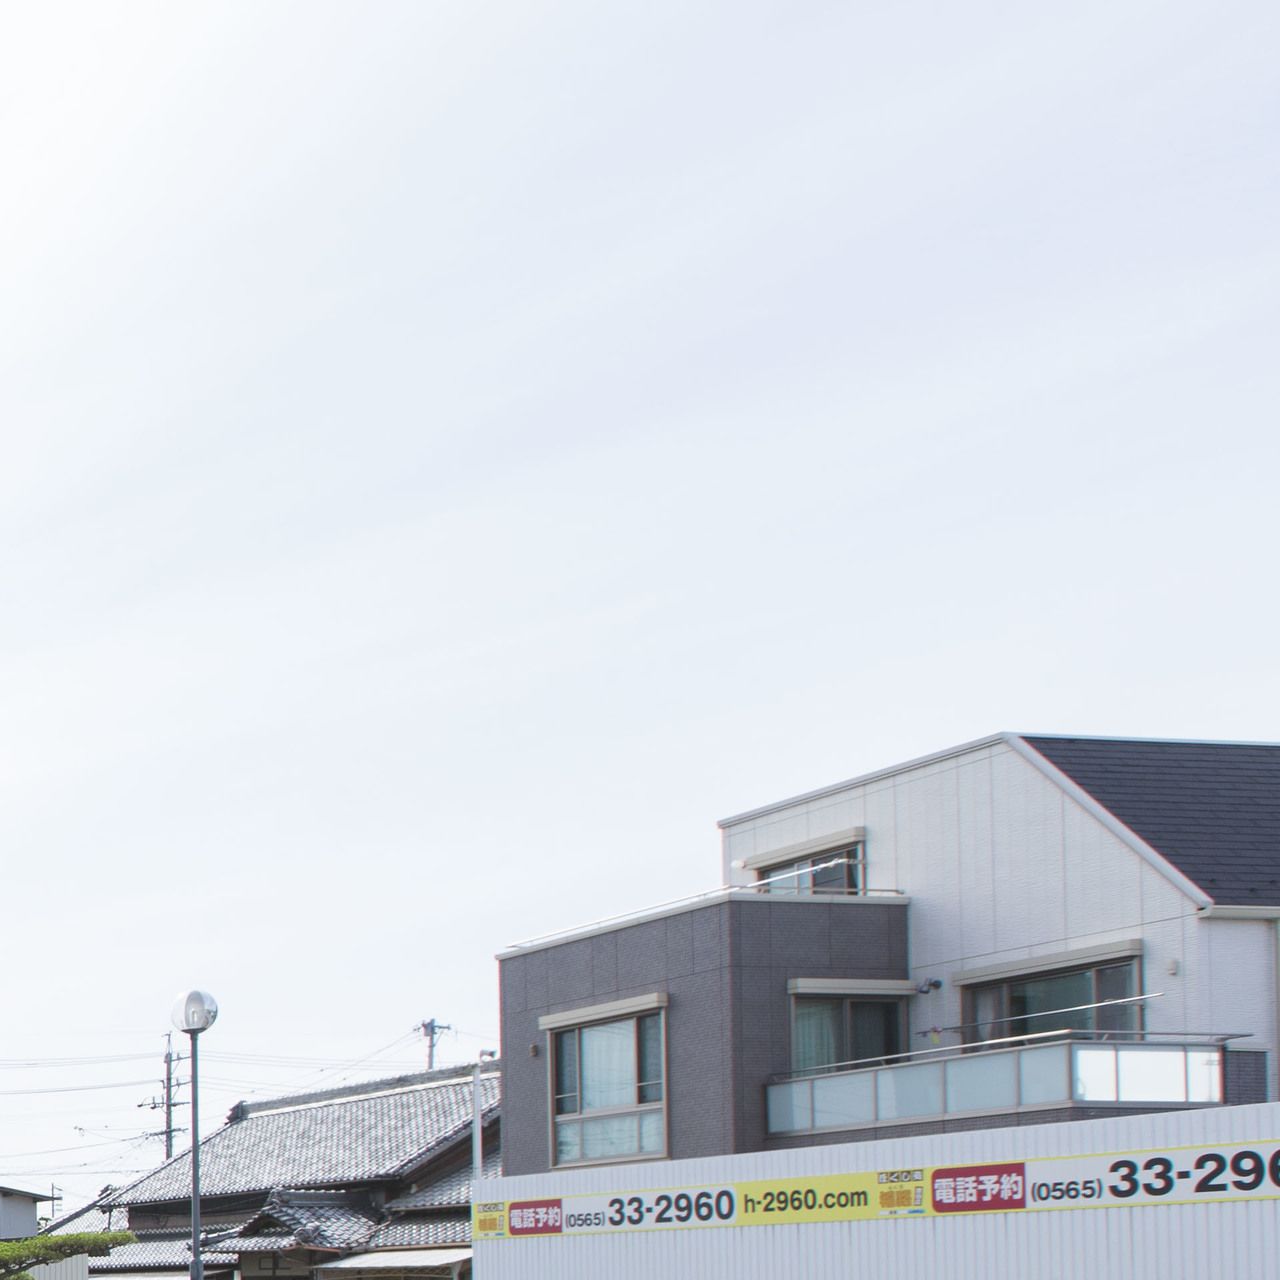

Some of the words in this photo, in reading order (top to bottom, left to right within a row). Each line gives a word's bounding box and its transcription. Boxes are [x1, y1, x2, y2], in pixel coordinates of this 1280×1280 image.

[934, 1174, 1023, 1203] 電話予約
[1031, 1178, 1102, 1201] (0565)
[510, 1206, 562, 1229] 電話予約
[565, 1211, 605, 1229] (0565)
[608, 1190, 735, 1226] 33-2960
[743, 1188, 868, 1214] h-2960.com
